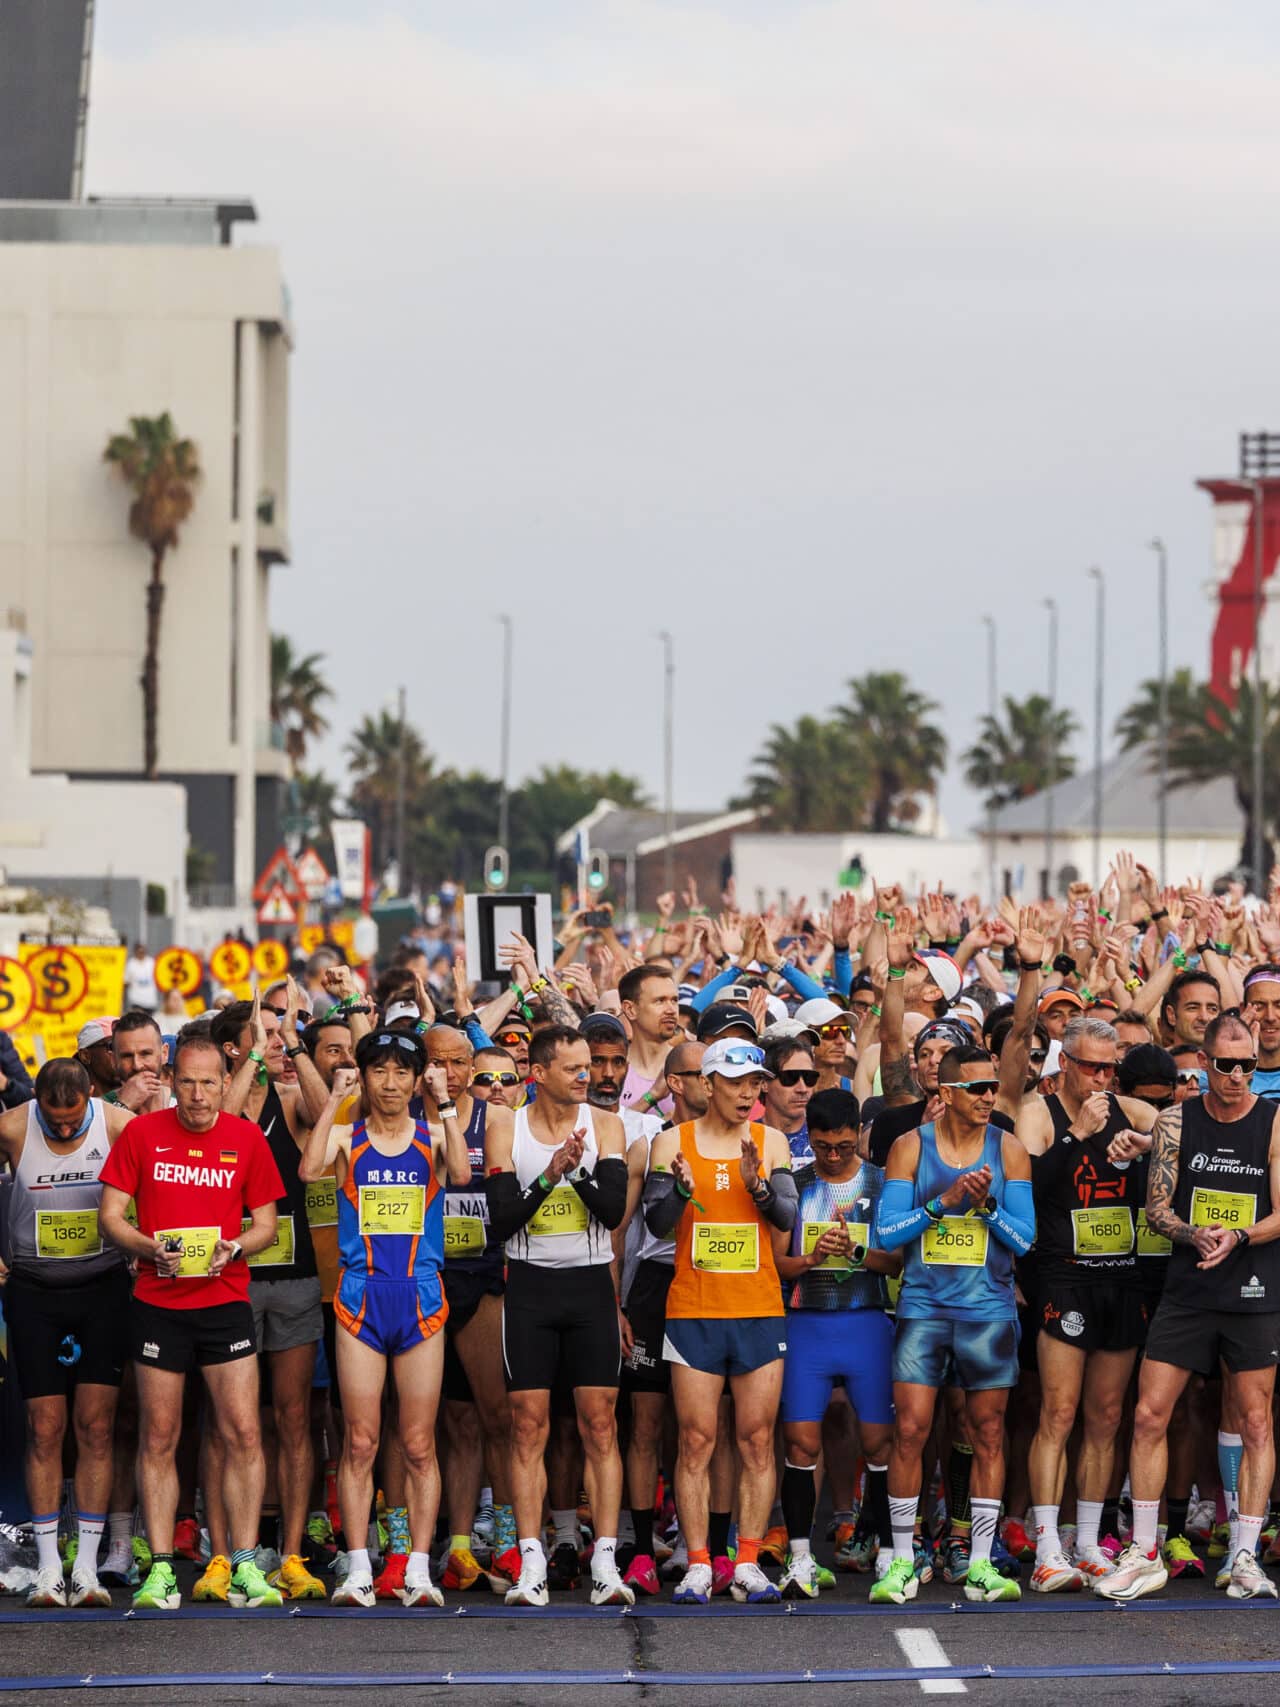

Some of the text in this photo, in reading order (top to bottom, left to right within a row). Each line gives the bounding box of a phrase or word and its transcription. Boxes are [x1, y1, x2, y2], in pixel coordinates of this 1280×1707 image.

[1211, 1155, 1241, 1165] Groupe
[37, 1171, 94, 1184] CUBE
[153, 1161, 236, 1189] GERMANY
[1206, 1164, 1265, 1177] armorine
[307, 1194, 335, 1208] 685
[377, 1203, 409, 1216] 2127
[541, 1202, 572, 1217] 2131
[1205, 1207, 1240, 1222] 1848
[53, 1227, 87, 1240] 1362
[1089, 1223, 1121, 1237] 1680
[446, 1232, 470, 1245] 514
[936, 1233, 974, 1247] 2063
[708, 1240, 745, 1254] 2807
